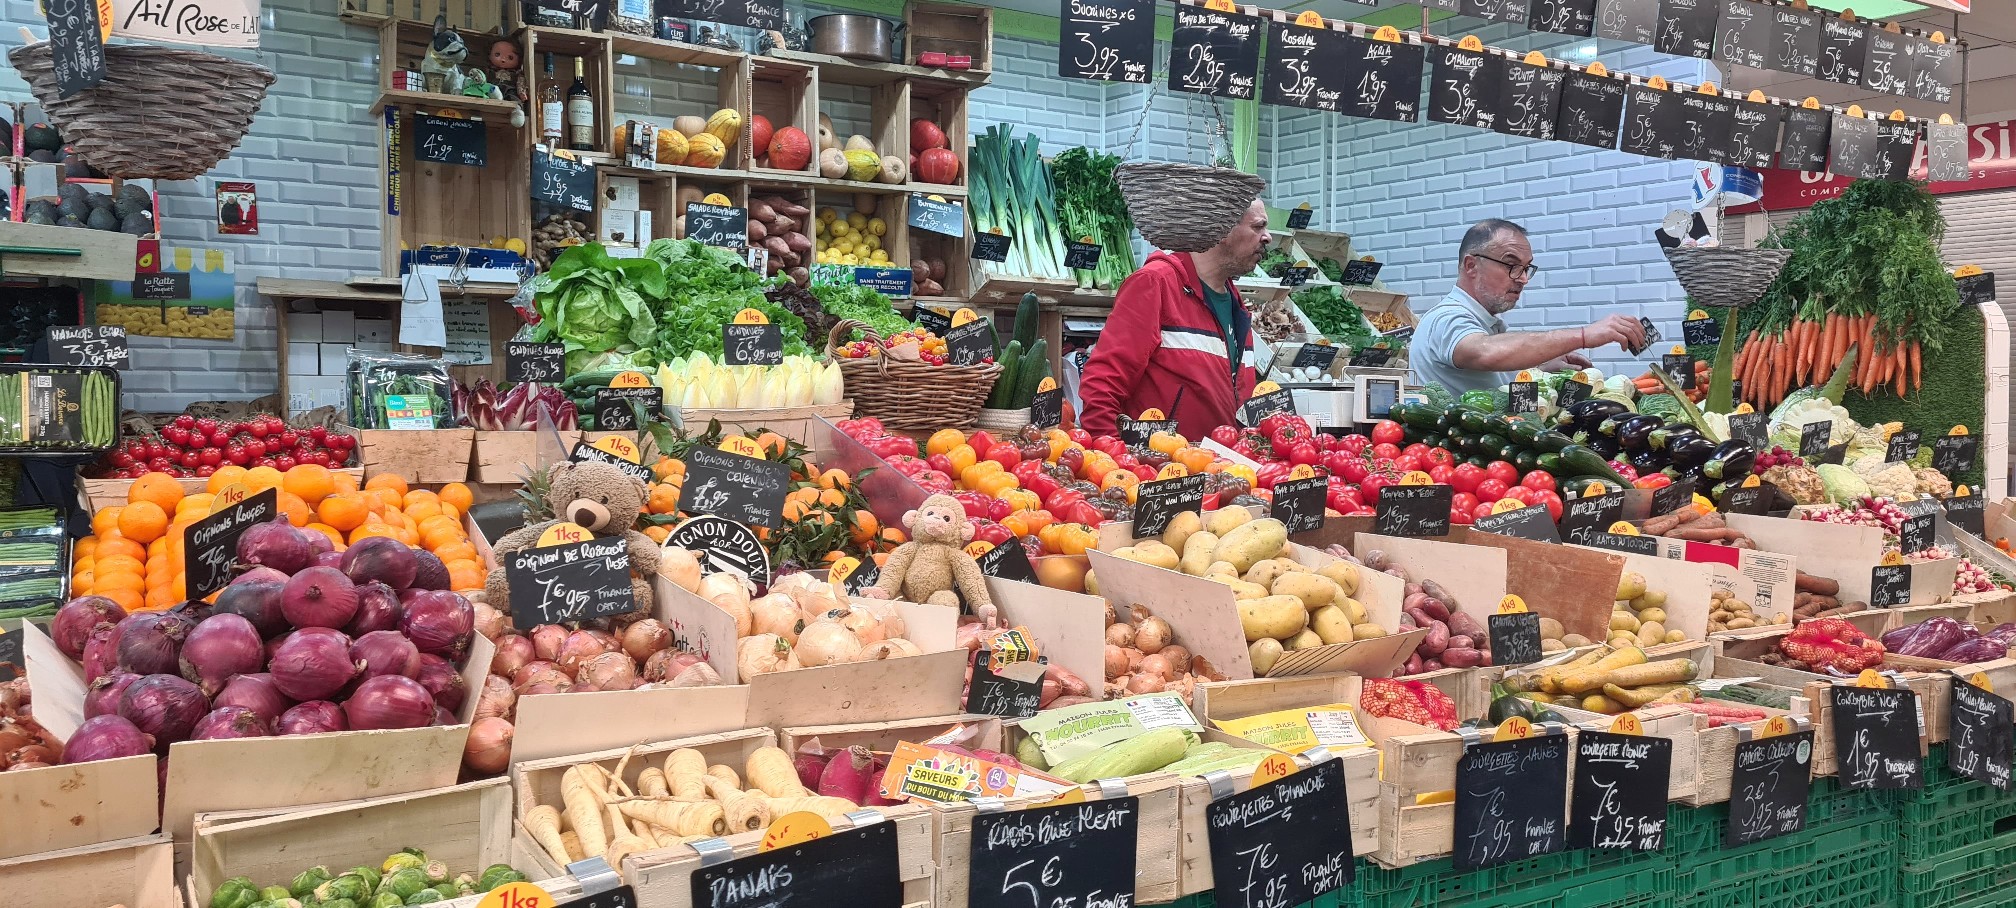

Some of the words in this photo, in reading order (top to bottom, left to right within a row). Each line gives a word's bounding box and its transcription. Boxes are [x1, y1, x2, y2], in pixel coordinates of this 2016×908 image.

[745, 2, 780, 18] FRANCE
[1214, 0, 1229, 10] 1kg
[1505, 3, 1526, 13] FRANCE
[123, 0, 169, 29] Ail
[1302, 14, 1318, 27] 1kg
[1281, 29, 1317, 47] ROSEVAL
[1382, 28, 1396, 41] 1kg
[1463, 38, 1477, 49] 1kg
[1122, 60, 1146, 73] FRANCE
[1229, 73, 1254, 87] FRANCE
[688, 203, 711, 213] SALADE
[153, 277, 175, 286] Ratte
[149, 285, 175, 294] Touquet
[743, 311, 761, 323] 1kg
[621, 373, 640, 385] 1kg
[610, 438, 631, 456] 1kg
[732, 440, 755, 456] 1kg
[1167, 468, 1182, 478] 1kg
[1297, 468, 1310, 479] 1kg
[1409, 471, 1426, 485] 1kg
[223, 490, 245, 503] 1kg
[742, 503, 772, 517] FRANCE
[1498, 501, 1517, 512] 1kg
[555, 525, 581, 544] 1kg
[1612, 525, 1628, 535] 1kg
[672, 521, 728, 550] IGNON
[730, 529, 766, 577] DOUX
[965, 545, 986, 558] 1kg
[515, 548, 560, 572] OIGNON
[1885, 553, 1896, 564] 1kg
[831, 563, 849, 581] 1kg
[594, 584, 633, 600] FRANCE
[1502, 599, 1516, 612] 1kg
[1058, 712, 1093, 725] MAISON
[1617, 716, 1635, 731] 1kg
[1044, 712, 1132, 742] NOURRIT
[1243, 725, 1274, 736] MAISON
[1508, 722, 1528, 738] 1kg
[1770, 721, 1782, 733] 1kg
[1580, 742, 1620, 758] COURGETTE
[1263, 757, 1288, 776] 1kg
[913, 768, 959, 788] SAVEURS
[906, 782, 917, 791] DU
[917, 786, 938, 797] BOUT
[1212, 794, 1275, 828] COURGETTES
[1524, 816, 1556, 838] FRANCE
[1637, 815, 1666, 836] FRANCE
[1302, 851, 1344, 886] FRANCE
[501, 888, 539, 908] 1kg
